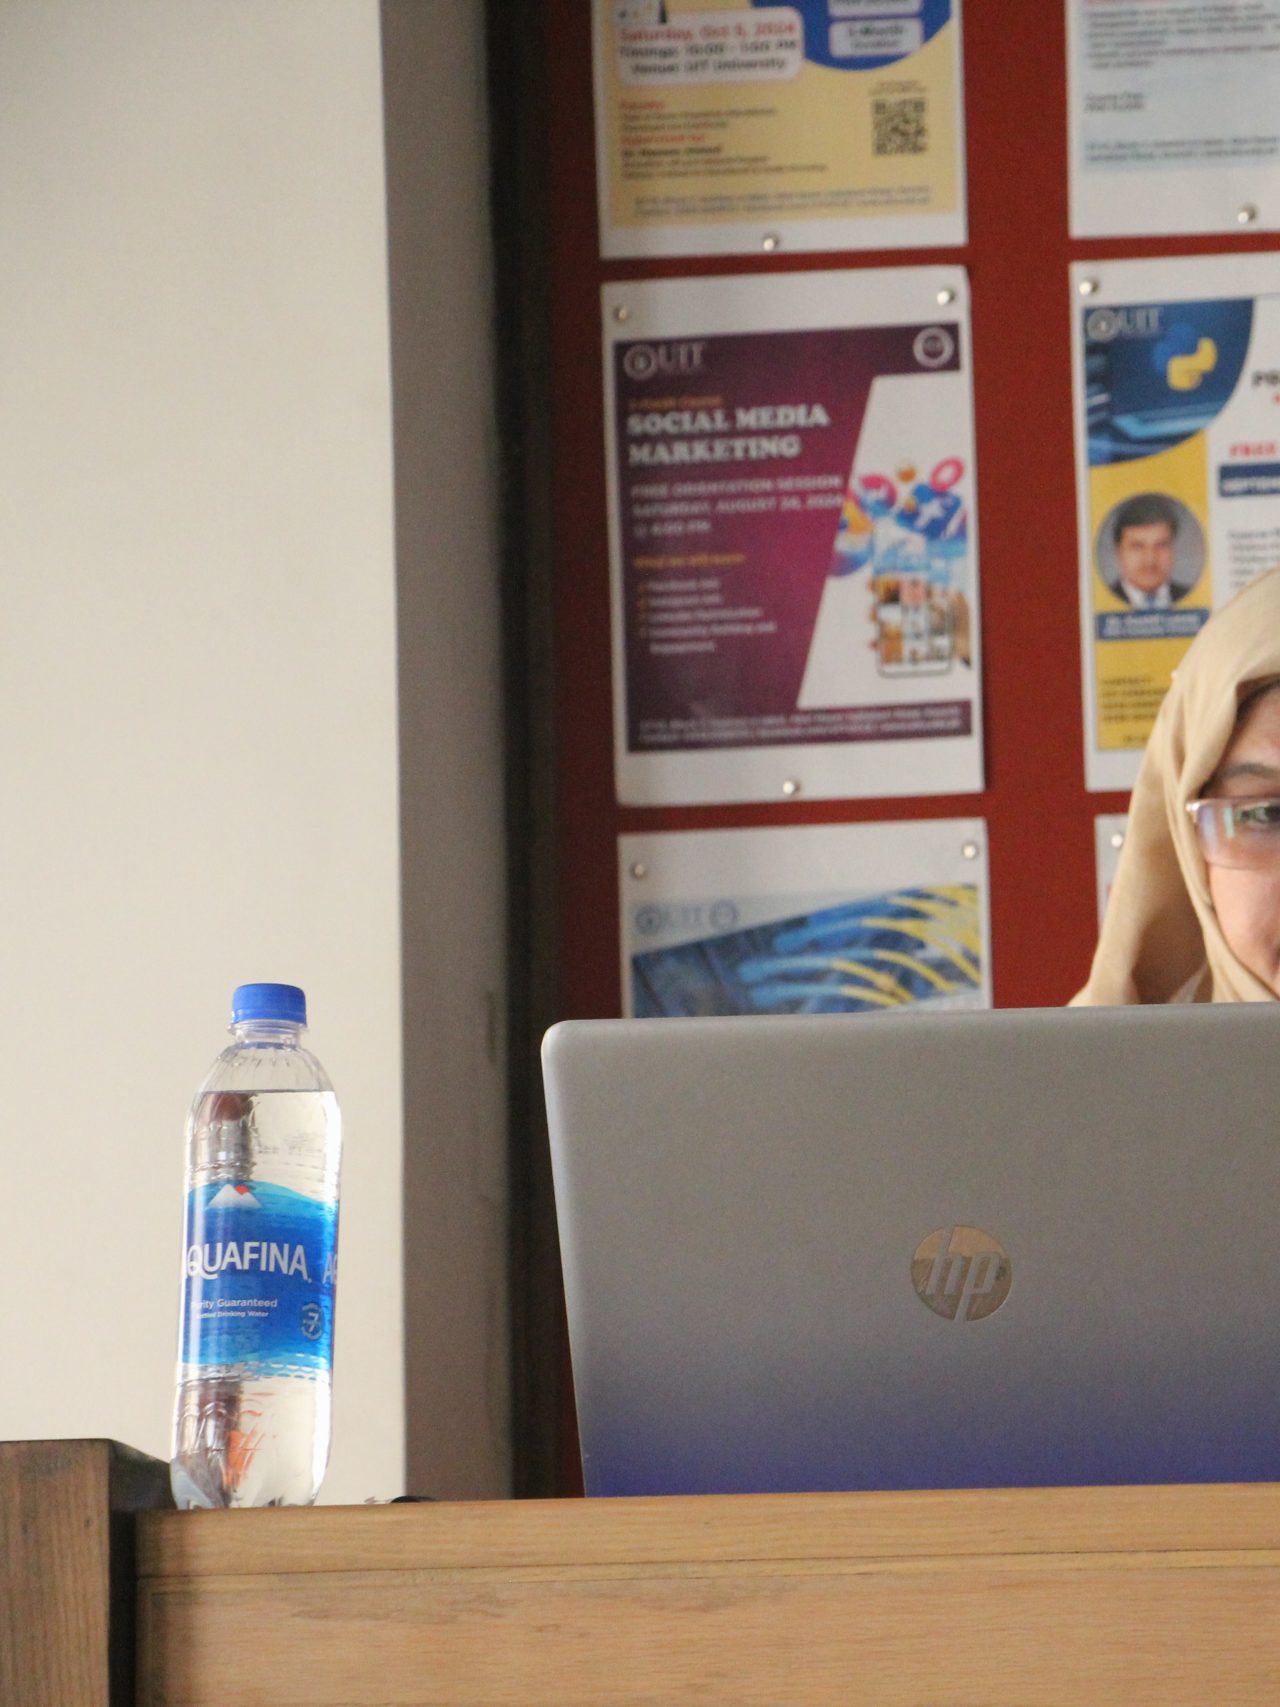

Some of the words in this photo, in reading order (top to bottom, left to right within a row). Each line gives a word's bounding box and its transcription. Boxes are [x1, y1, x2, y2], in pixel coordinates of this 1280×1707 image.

[1118, 307, 1161, 333] UIT
[659, 342, 705, 370] UIT
[627, 407, 729, 435] SOCIAL
[735, 403, 831, 429] MEDIA
[628, 434, 802, 466] MARKETING
[1230, 442, 1276, 459] FREE
[672, 477, 774, 495] ORIENTATION
[777, 474, 842, 491] SESSION
[716, 495, 780, 513] AUGUST
[186, 1241, 313, 1283] QUAFINA
[922, 1225, 1001, 1321] hp
[217, 1298, 278, 1307] Guaranteed
